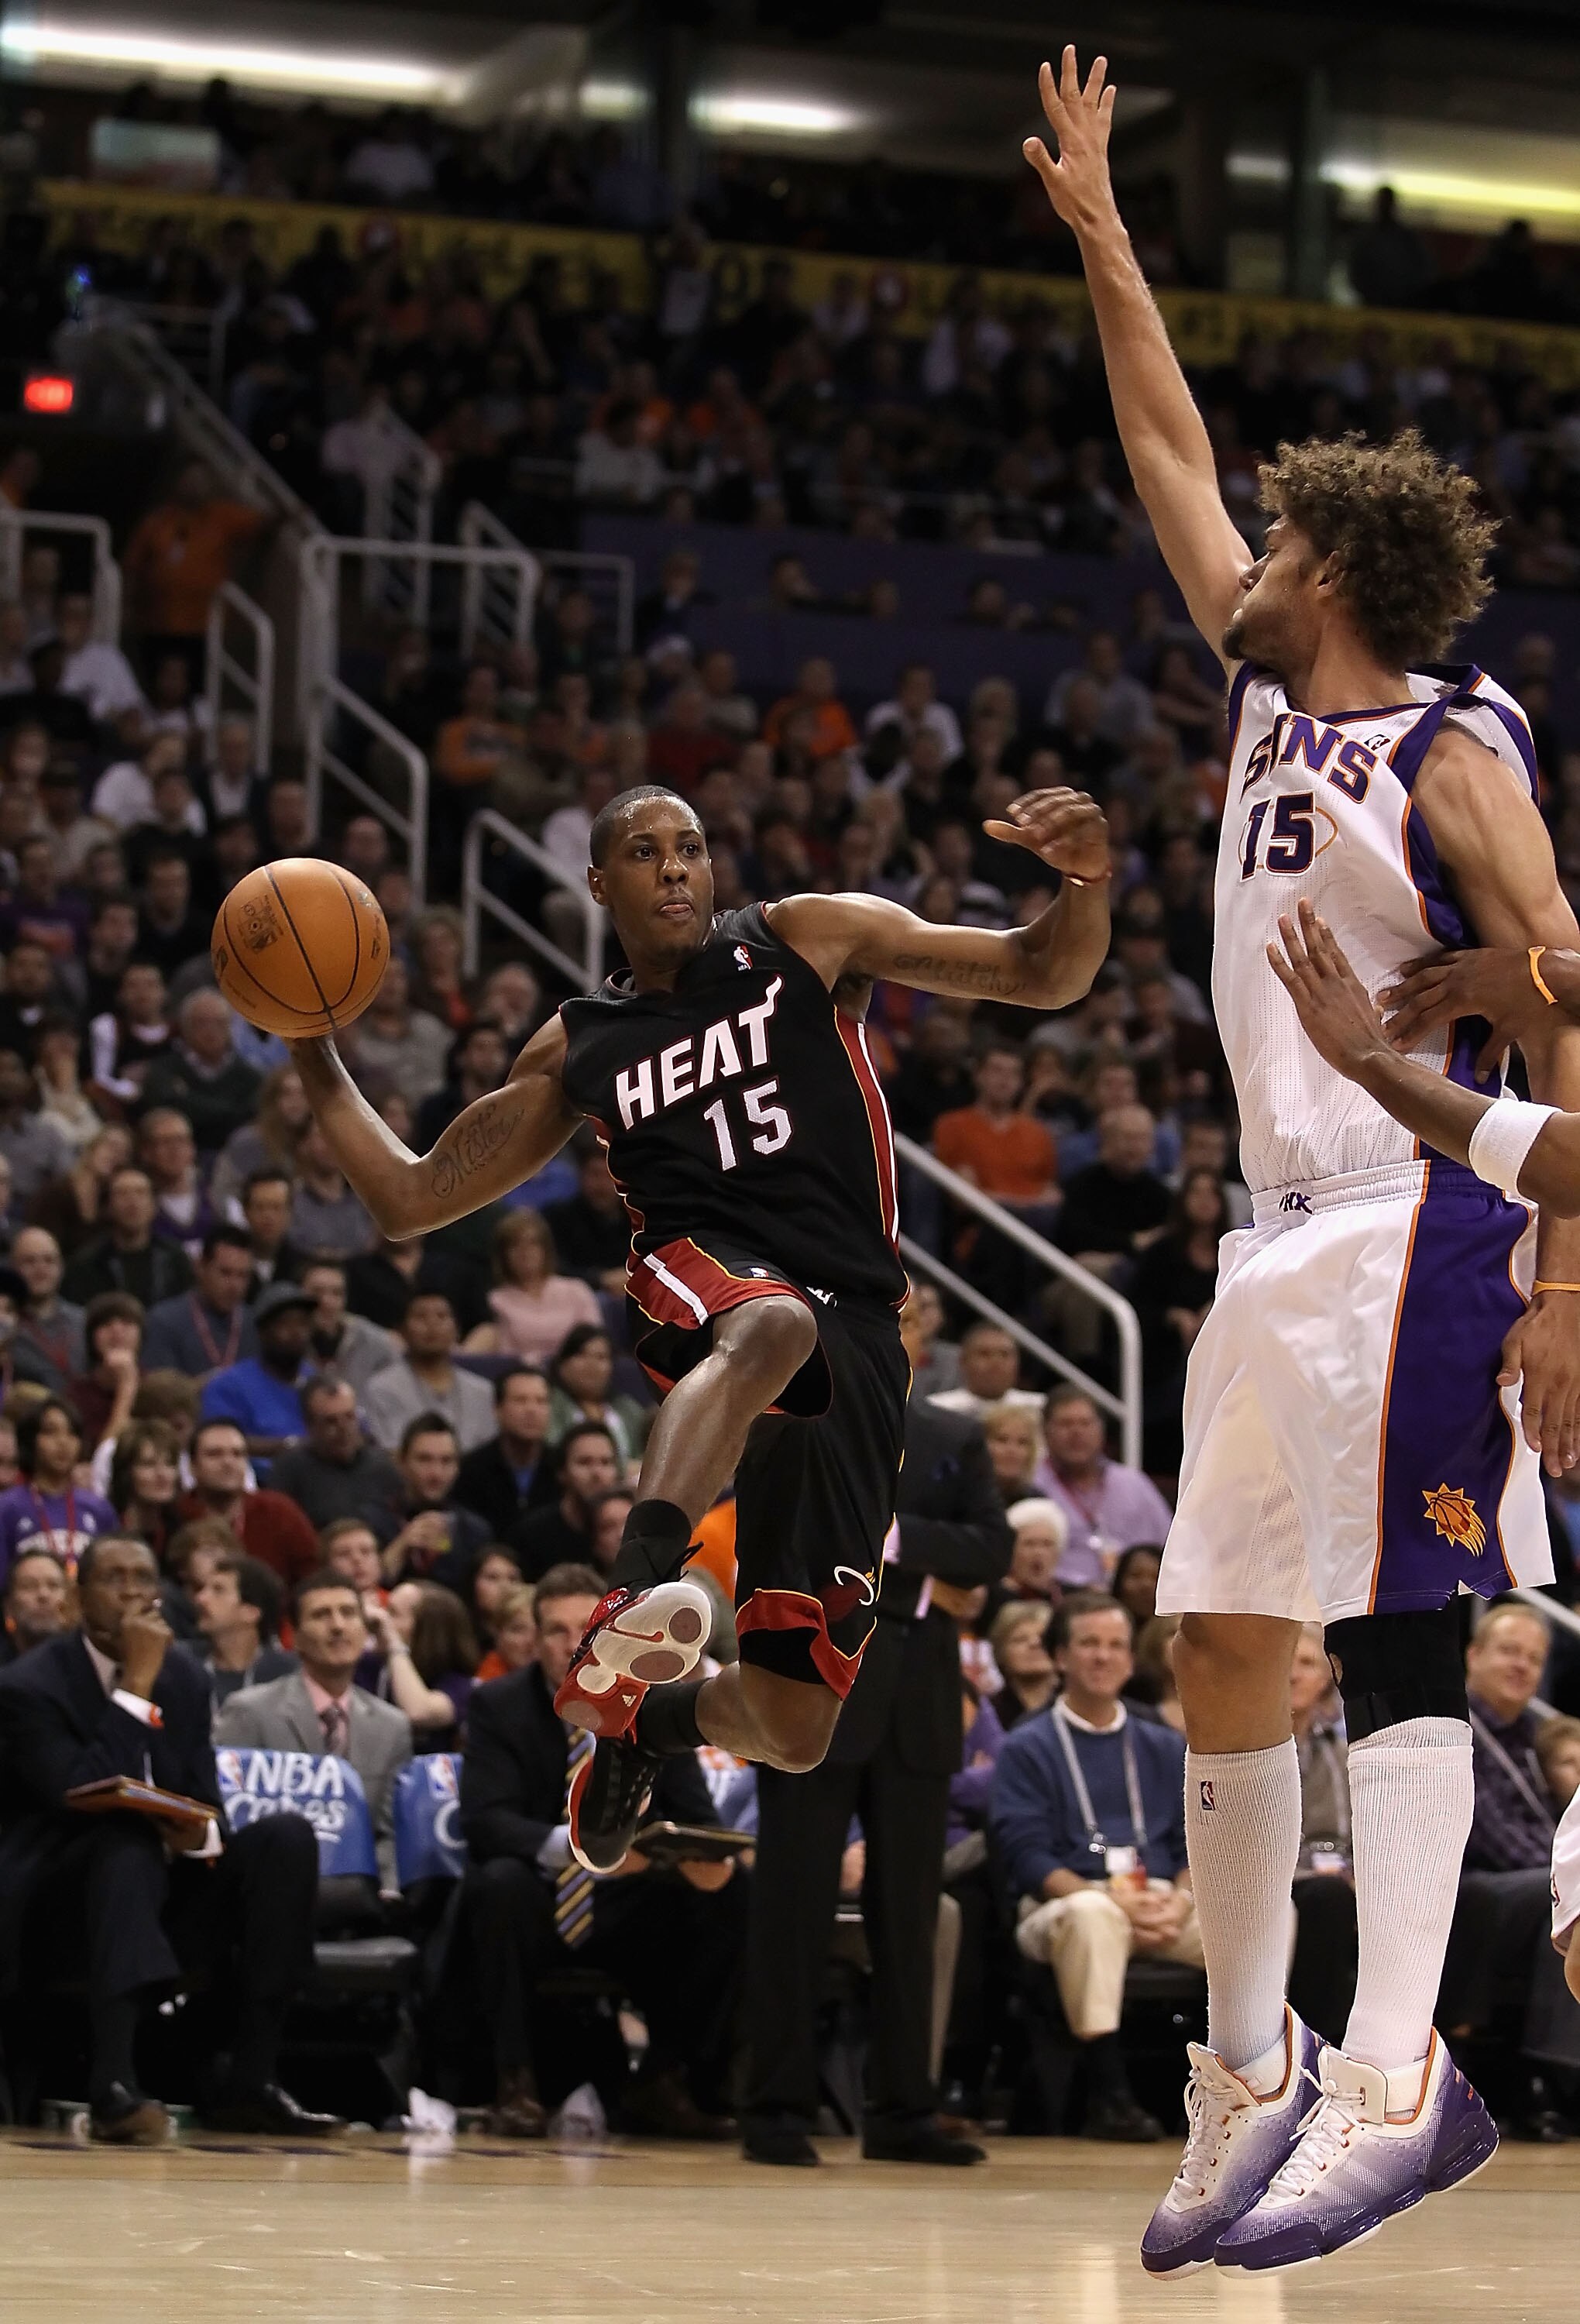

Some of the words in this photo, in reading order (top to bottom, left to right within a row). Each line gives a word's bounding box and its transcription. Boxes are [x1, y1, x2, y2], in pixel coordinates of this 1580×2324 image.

[1241, 792, 1316, 882] 15
[614, 975, 784, 1131] HEAT
[702, 1079, 793, 1172] 15
[1279, 1191, 1313, 1215] HX
[246, 1749, 344, 1796] NBA
